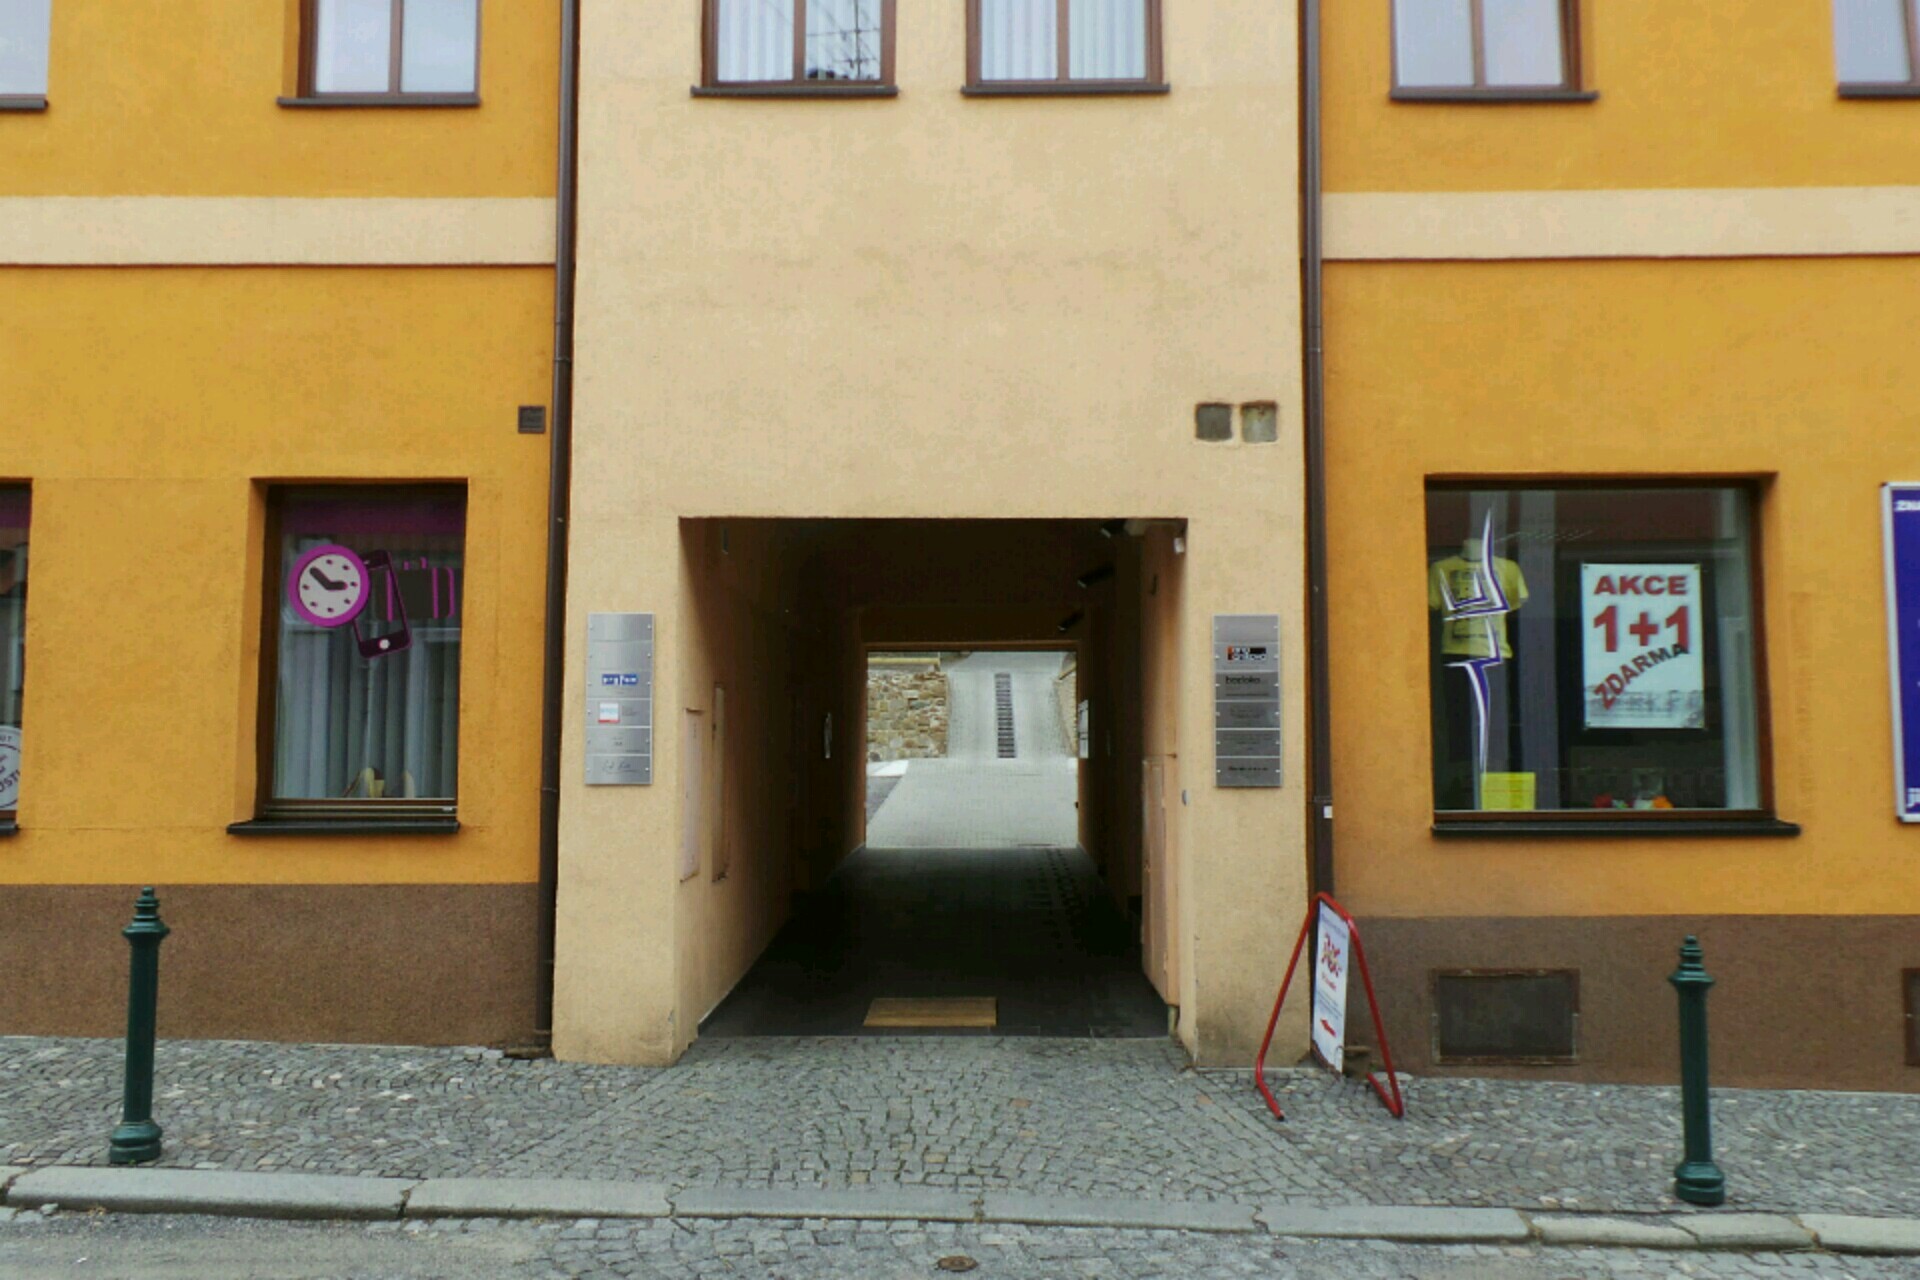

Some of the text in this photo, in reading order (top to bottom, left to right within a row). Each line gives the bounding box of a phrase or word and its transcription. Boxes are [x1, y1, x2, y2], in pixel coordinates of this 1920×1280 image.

[1594, 575, 1688, 595] AKCE
[1594, 605, 1689, 653] 1+1
[1594, 643, 1689, 710] ZDARMA
